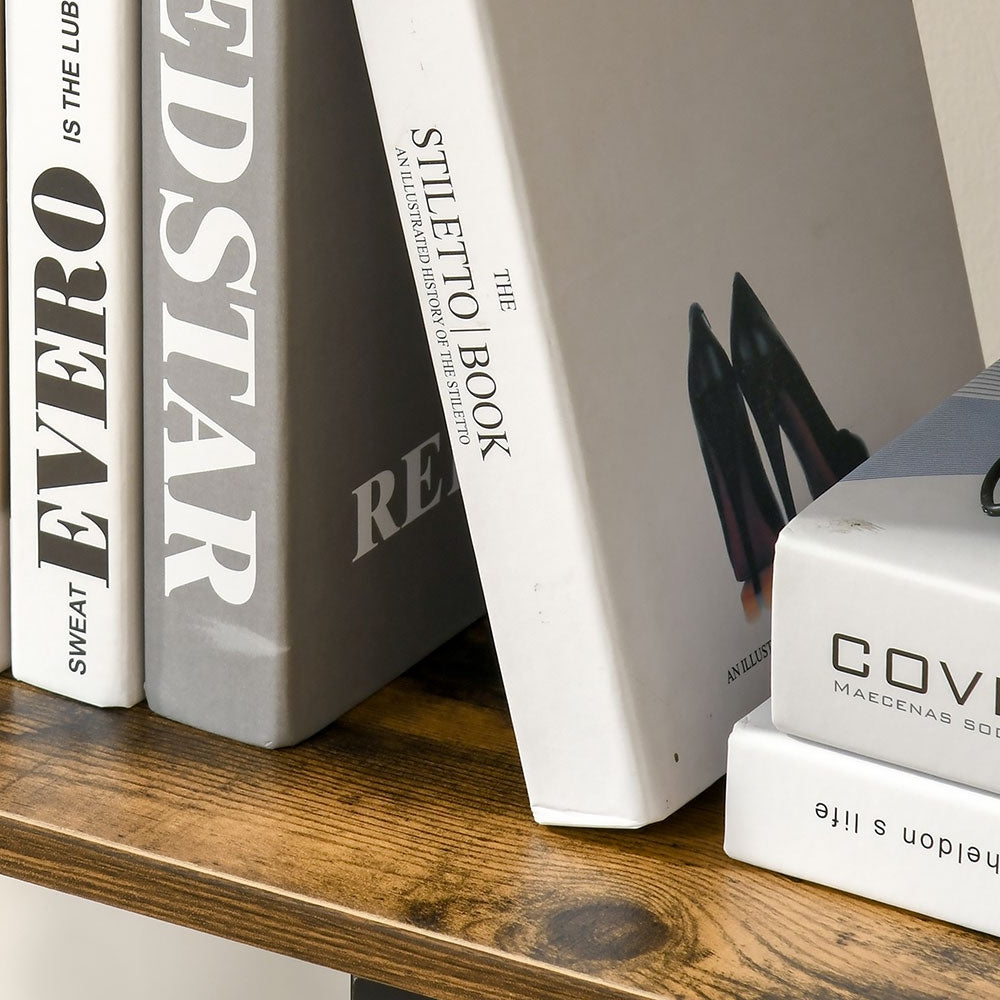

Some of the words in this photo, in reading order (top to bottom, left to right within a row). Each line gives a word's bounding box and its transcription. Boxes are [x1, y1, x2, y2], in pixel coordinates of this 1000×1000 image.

[62, 59, 80, 110] THE
[63, 118, 81, 144] IS
[395, 147, 410, 167] AN
[400, 171, 431, 264] ILLUSTRATED
[410, 127, 479, 320] STILETTO
[457, 343, 512, 462] BOOK
[421, 267, 446, 326] HISTORY
[493, 268, 517, 312] THE
[435, 329, 450, 349] OF
[440, 350, 456, 378] THE
[31, 166, 109, 589] EVERO
[446, 381, 470, 446] STILETTO
[352, 432, 460, 563] RE
[68, 582, 89, 675] SWEAT
[727, 663, 741, 685] AN
[832, 632, 1000, 716] COV
[834, 680, 951, 724] MAECENAS
[815, 802, 859, 834] life
